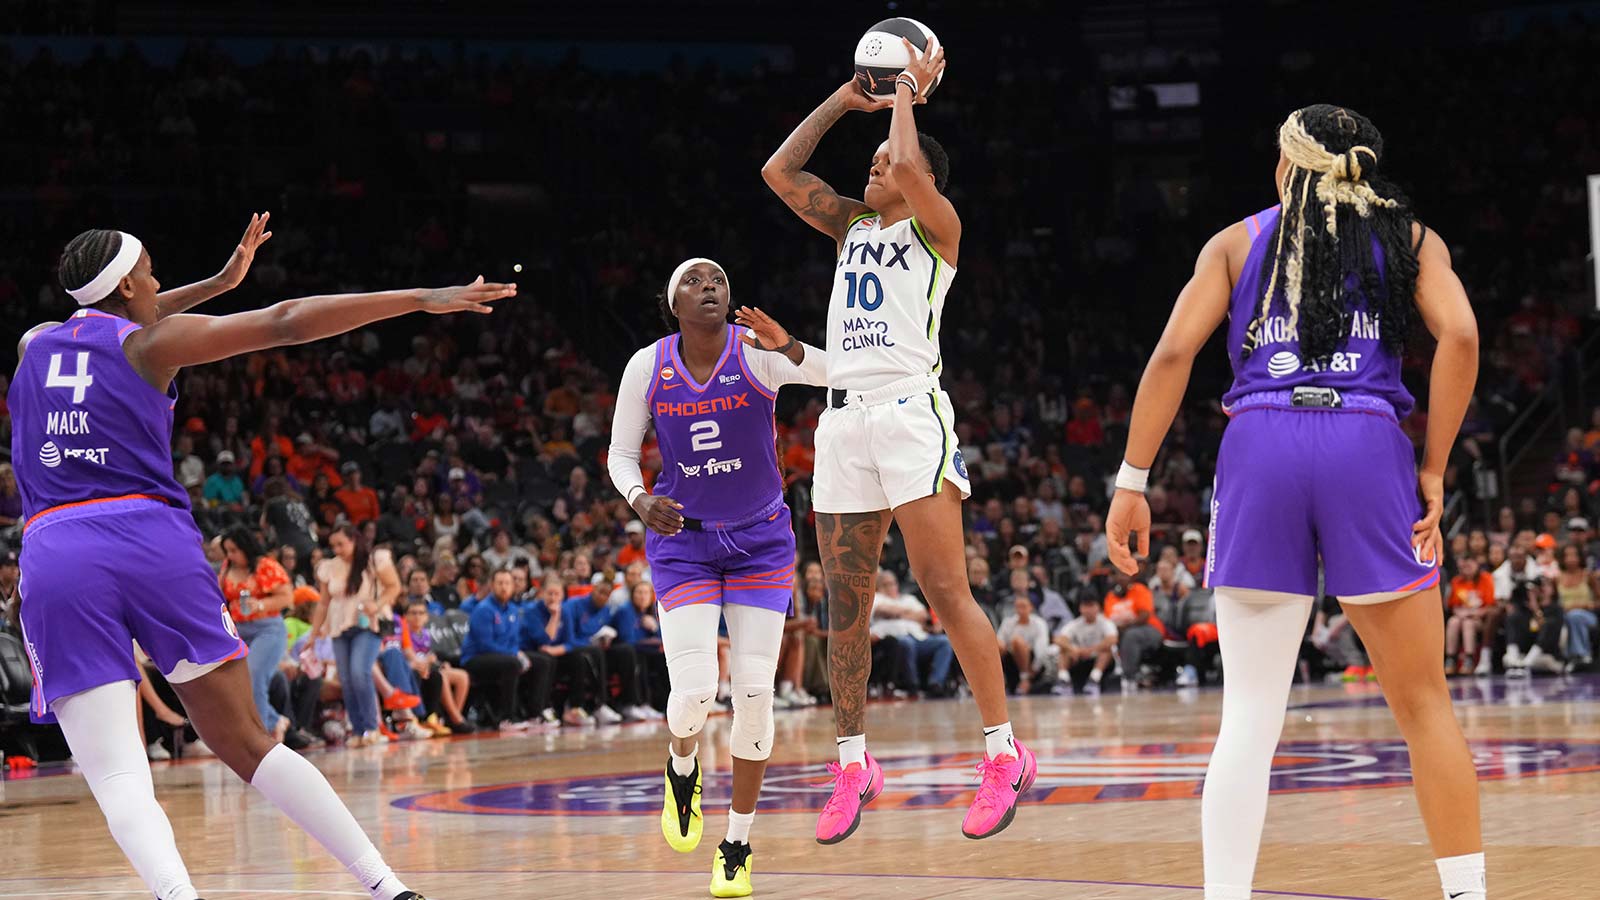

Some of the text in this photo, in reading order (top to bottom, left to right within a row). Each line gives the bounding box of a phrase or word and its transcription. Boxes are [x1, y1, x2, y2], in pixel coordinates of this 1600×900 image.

[844, 271, 884, 312] 10
[842, 333, 895, 351] CLINIC
[45, 351, 93, 404] 4
[656, 392, 751, 417] PHOENIX
[46, 411, 90, 435] MACK
[689, 420, 723, 452] 2
